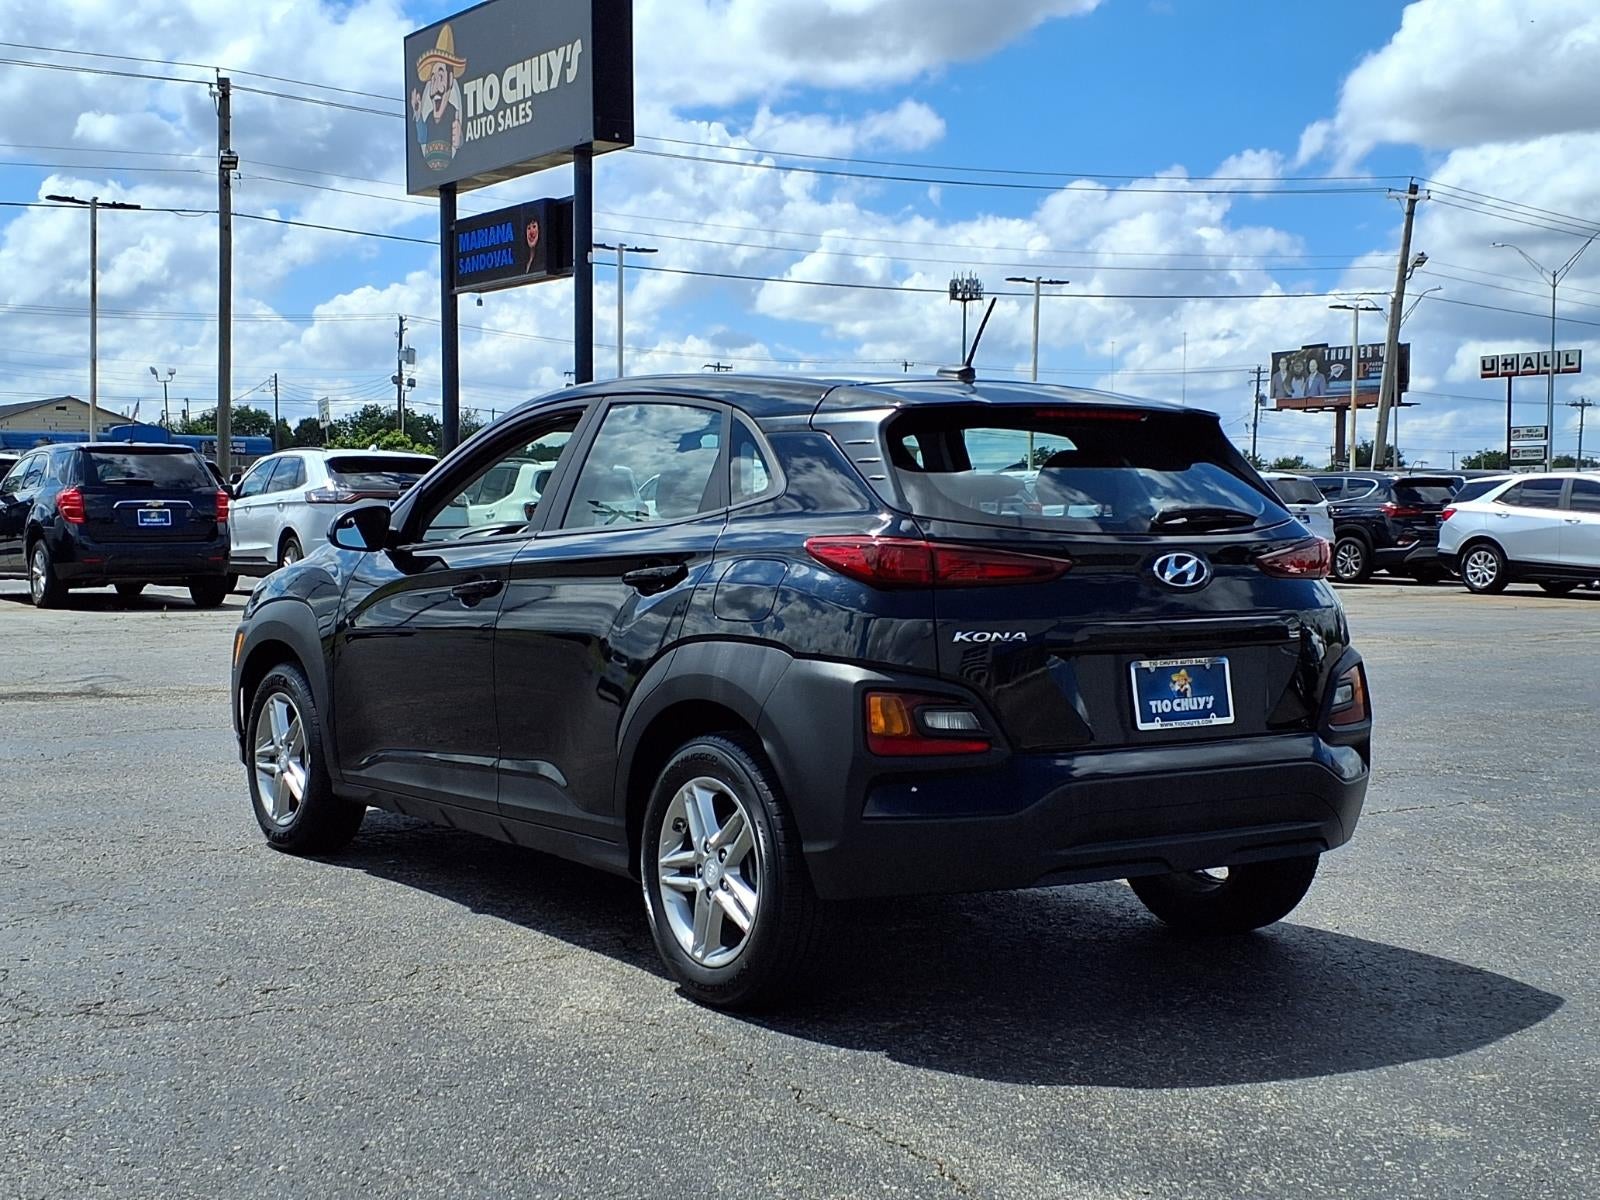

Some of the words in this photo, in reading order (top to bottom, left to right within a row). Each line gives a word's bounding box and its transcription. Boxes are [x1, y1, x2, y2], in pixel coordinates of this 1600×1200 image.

[463, 73, 500, 118] TIO
[502, 39, 583, 103] CHUY'S
[465, 118, 495, 142] AUTO
[497, 101, 533, 133] SALES
[458, 222, 514, 252] MARIANA
[458, 248, 514, 274] SANDOVAL
[1324, 346, 1372, 361] THUNER
[952, 631, 1028, 643] KONA
[1149, 699, 1172, 714] TIO
[1173, 695, 1214, 712] CHUY'S
